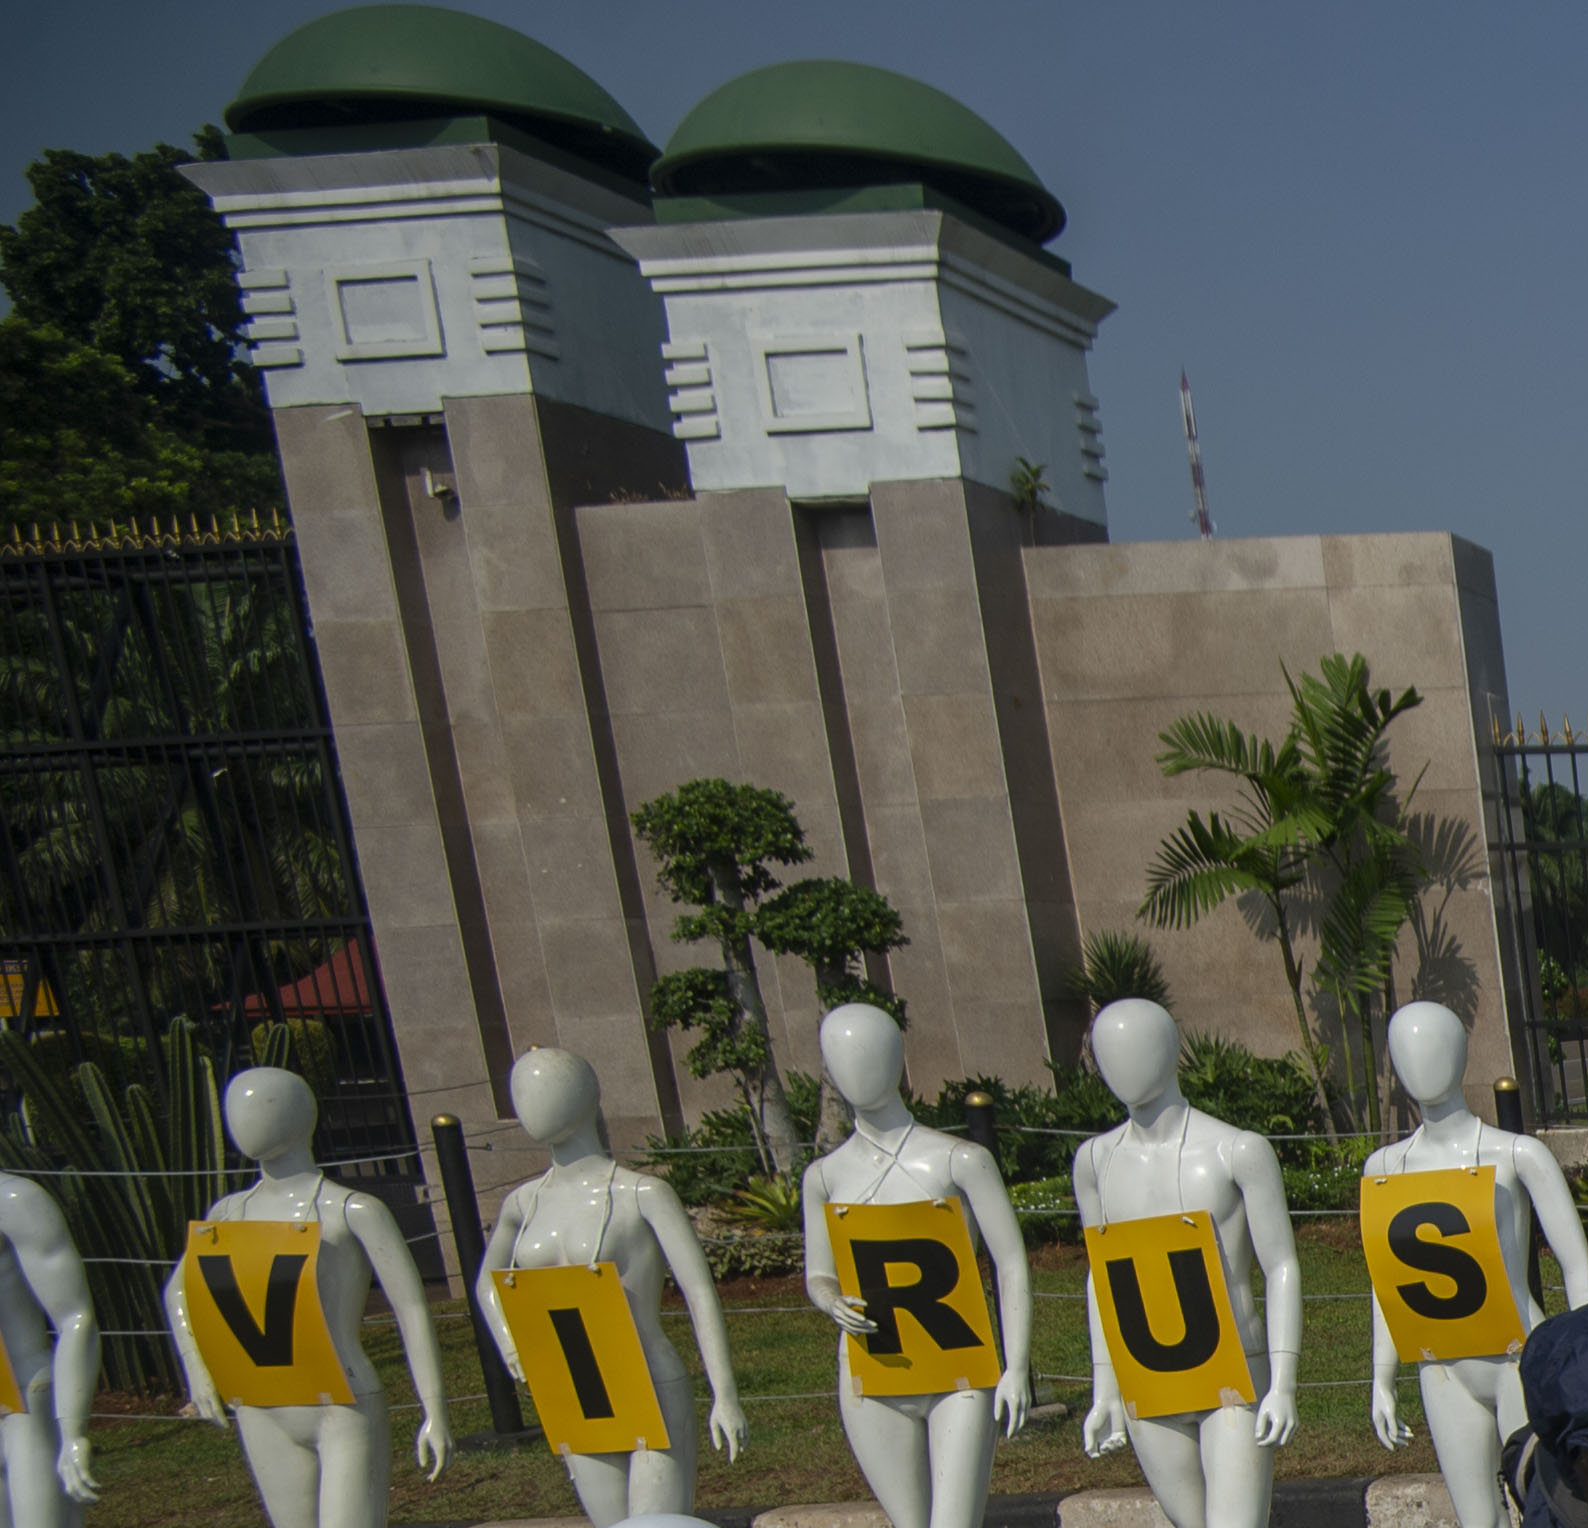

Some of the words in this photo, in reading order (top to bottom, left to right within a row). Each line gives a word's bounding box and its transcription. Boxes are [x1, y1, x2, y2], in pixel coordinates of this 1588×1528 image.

[198, 1255, 307, 1366] V
[850, 1239, 984, 1355] R
[1106, 1248, 1219, 1372] U
[1388, 1203, 1486, 1319] S
[548, 1308, 614, 1419] I
